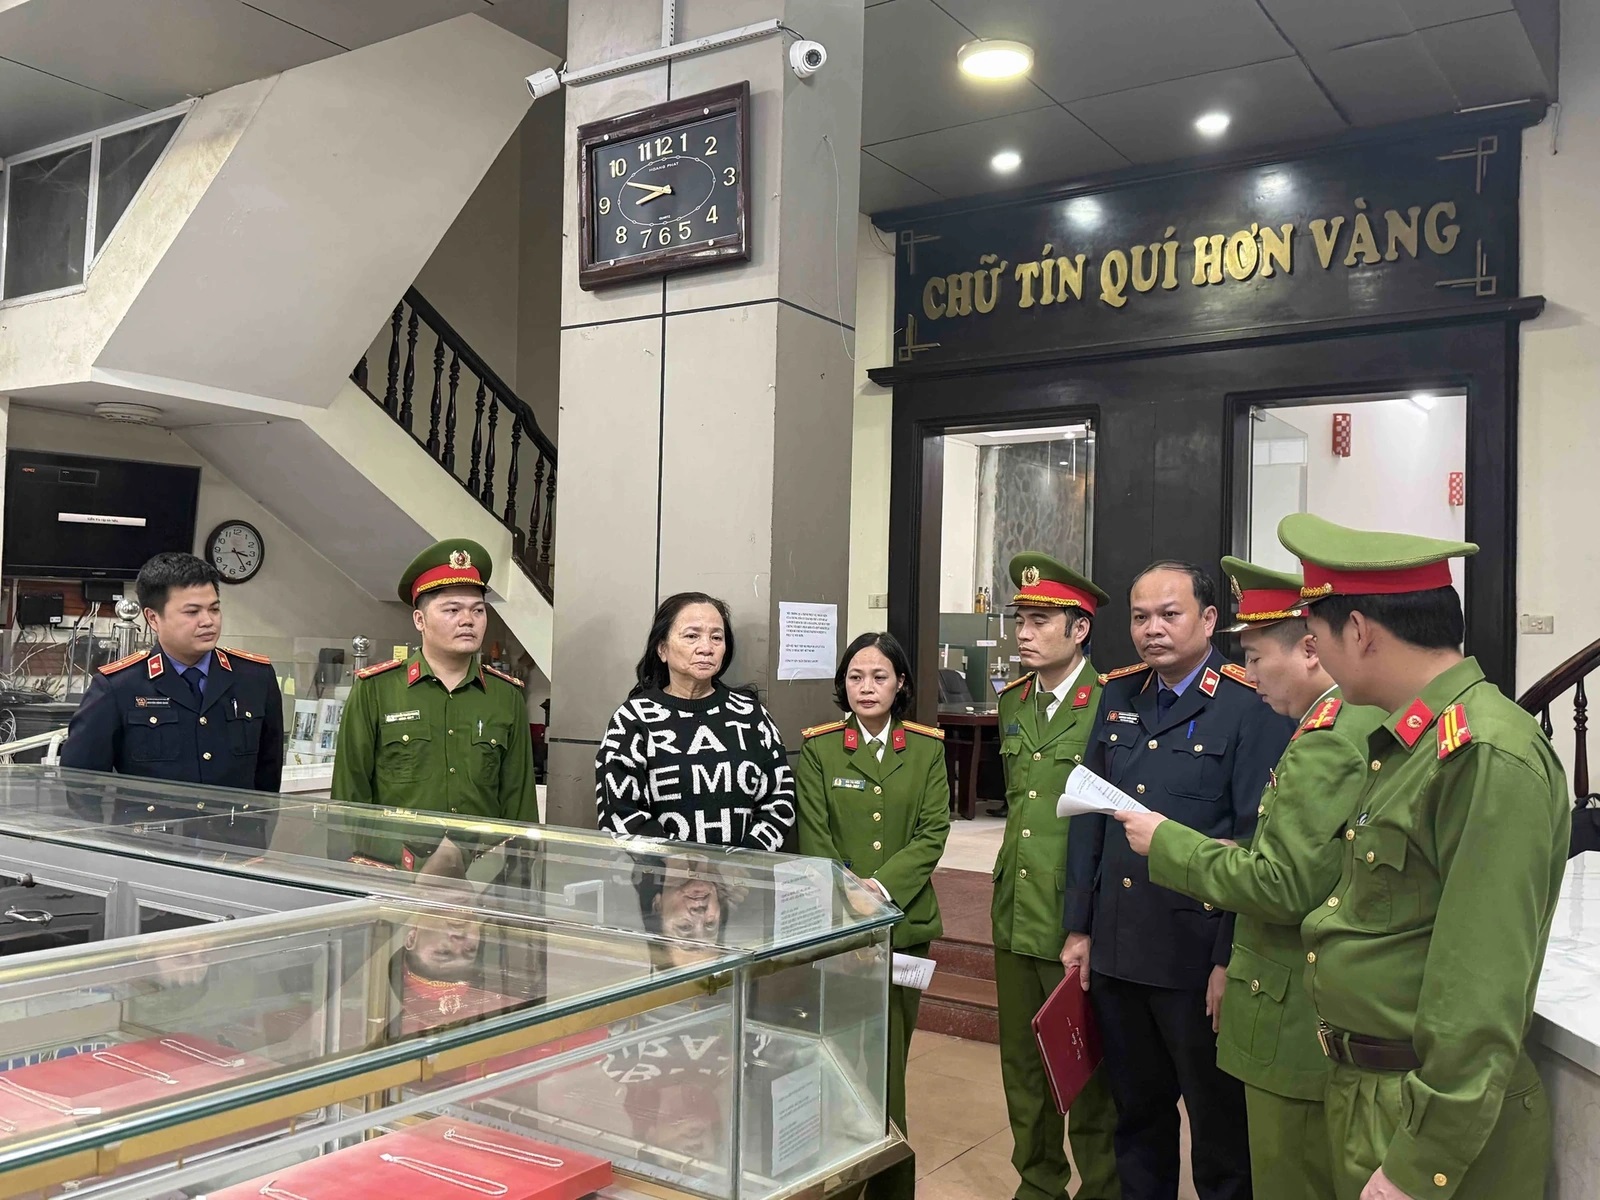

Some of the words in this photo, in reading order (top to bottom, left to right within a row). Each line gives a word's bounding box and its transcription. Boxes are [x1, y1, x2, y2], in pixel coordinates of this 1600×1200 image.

[638, 141, 652, 162] 11
[655, 136, 674, 157] 12
[680, 132, 688, 152] 1
[704, 136, 718, 156] 2
[609, 158, 627, 178] 10
[723, 167, 736, 187] 3
[599, 196, 611, 215] 9
[706, 205, 718, 224] 4
[616, 226, 627, 244] 8
[640, 229, 652, 249] 7
[659, 227, 671, 245] 6
[679, 220, 691, 240] 5
[923, 254, 1008, 320] CHỮ
[1015, 243, 1086, 308] TÍN
[1100, 226, 1180, 308] QUÍ
[1192, 213, 1293, 285] HƠN
[1309, 197, 1460, 269] VÀNG
